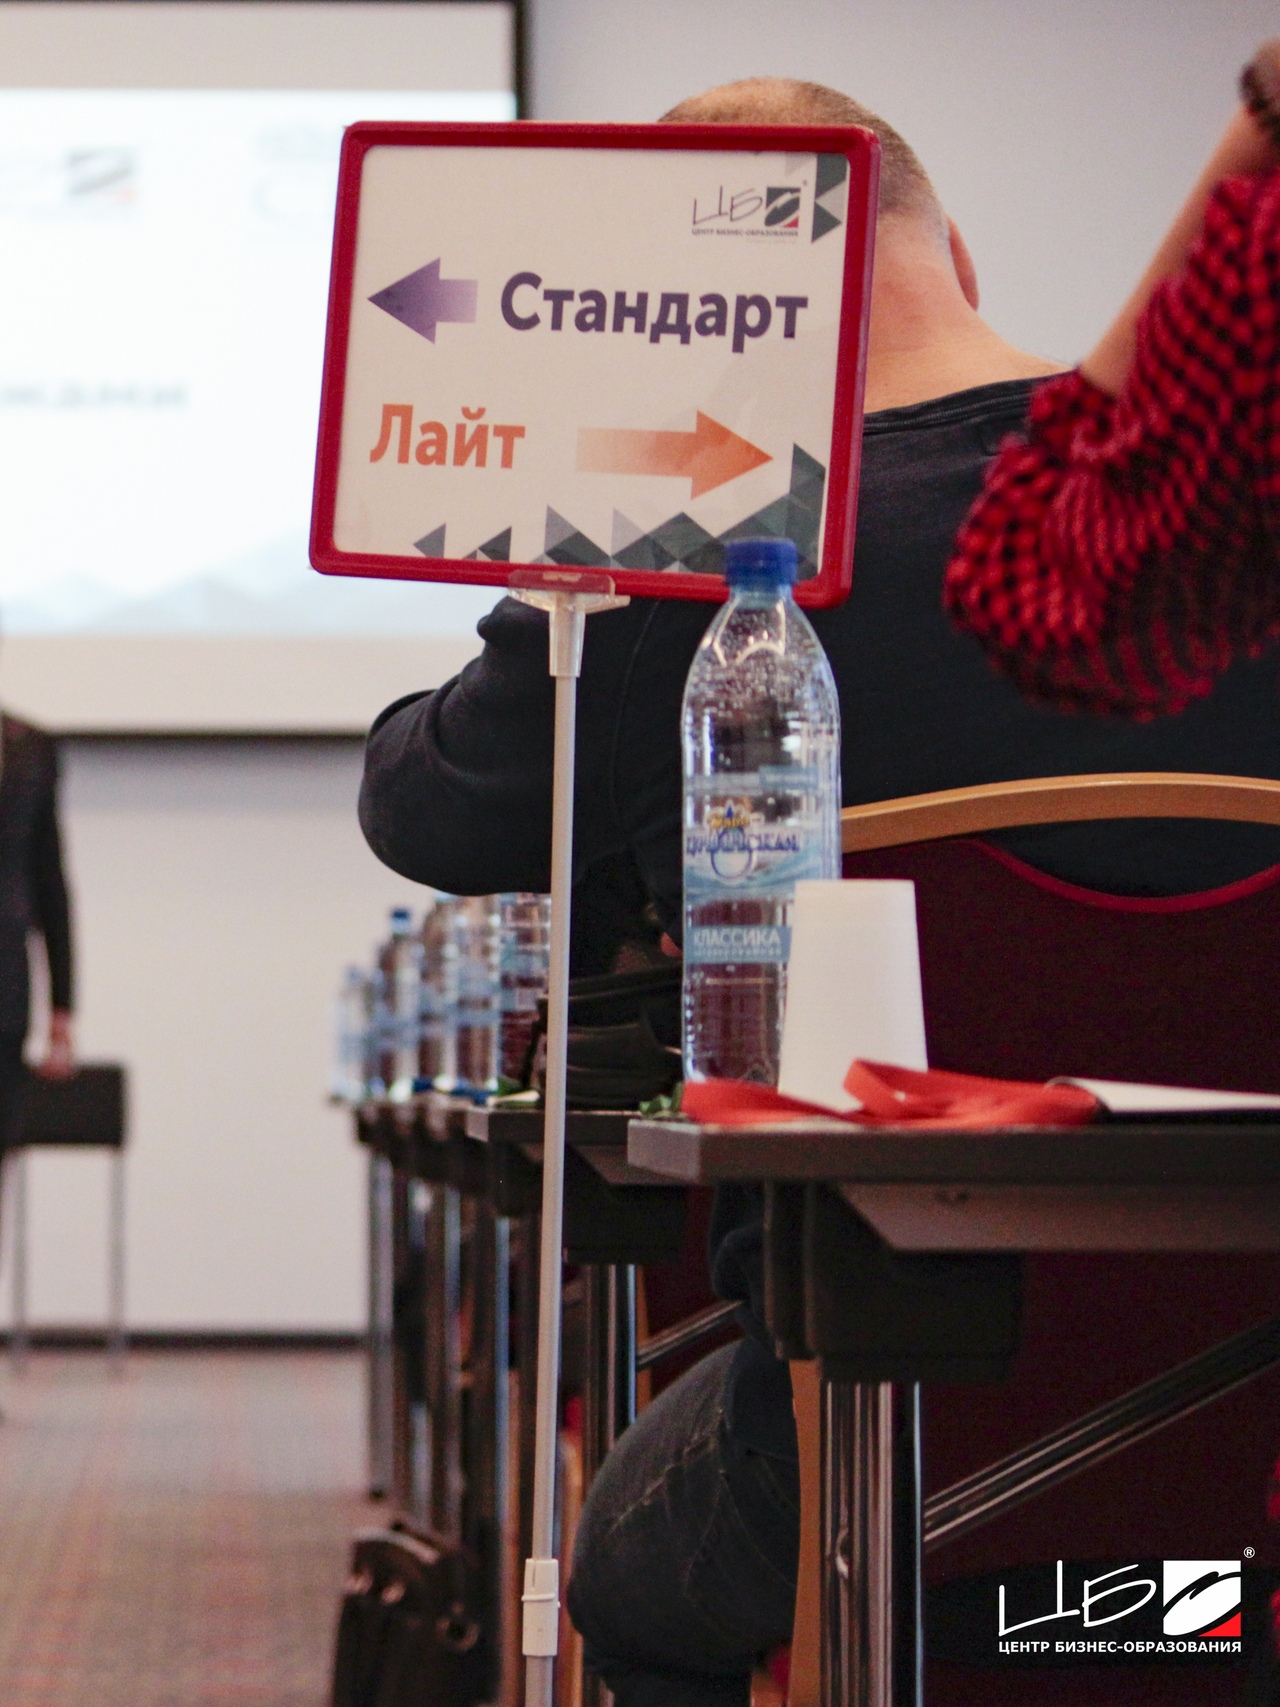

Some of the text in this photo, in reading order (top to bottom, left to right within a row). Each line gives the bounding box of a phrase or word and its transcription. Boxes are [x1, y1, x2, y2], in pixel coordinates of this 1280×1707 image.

[500, 270, 810, 355] Стандарт
[369, 403, 527, 470] Лайт
[693, 927, 782, 947] КЛАССИКА
